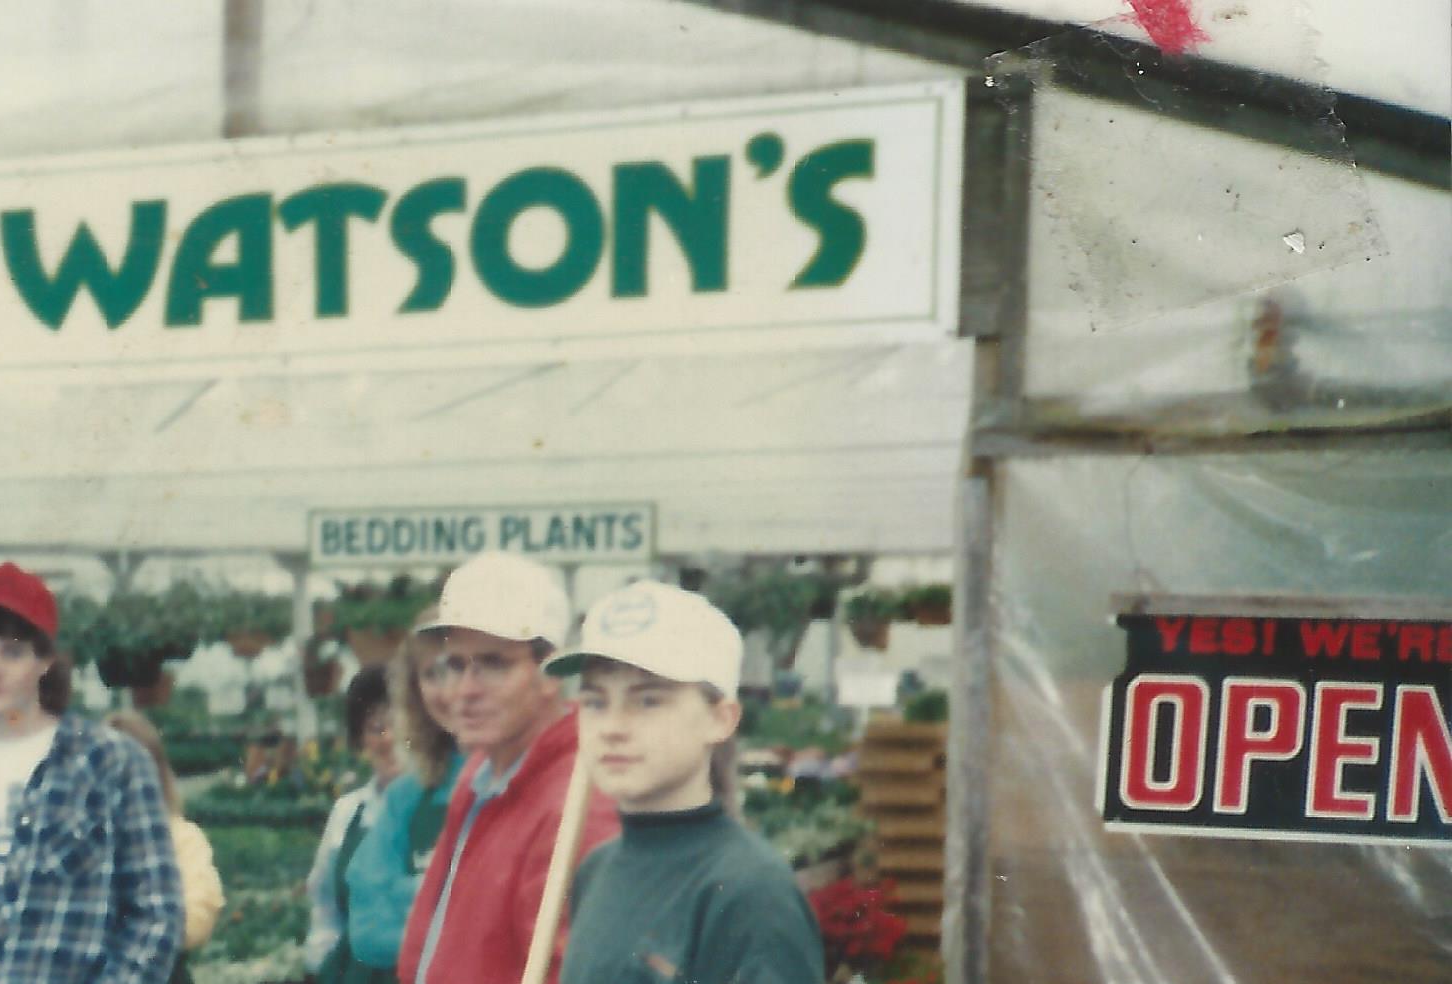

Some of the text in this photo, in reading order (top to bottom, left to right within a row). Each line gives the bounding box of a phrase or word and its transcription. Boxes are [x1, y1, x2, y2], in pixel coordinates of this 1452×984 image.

[0, 132, 876, 331] WATSON'S
[321, 511, 644, 554] BEDDING PLANTS
[1155, 617, 1279, 656] YES!
[1119, 673, 1452, 823] OPEN
